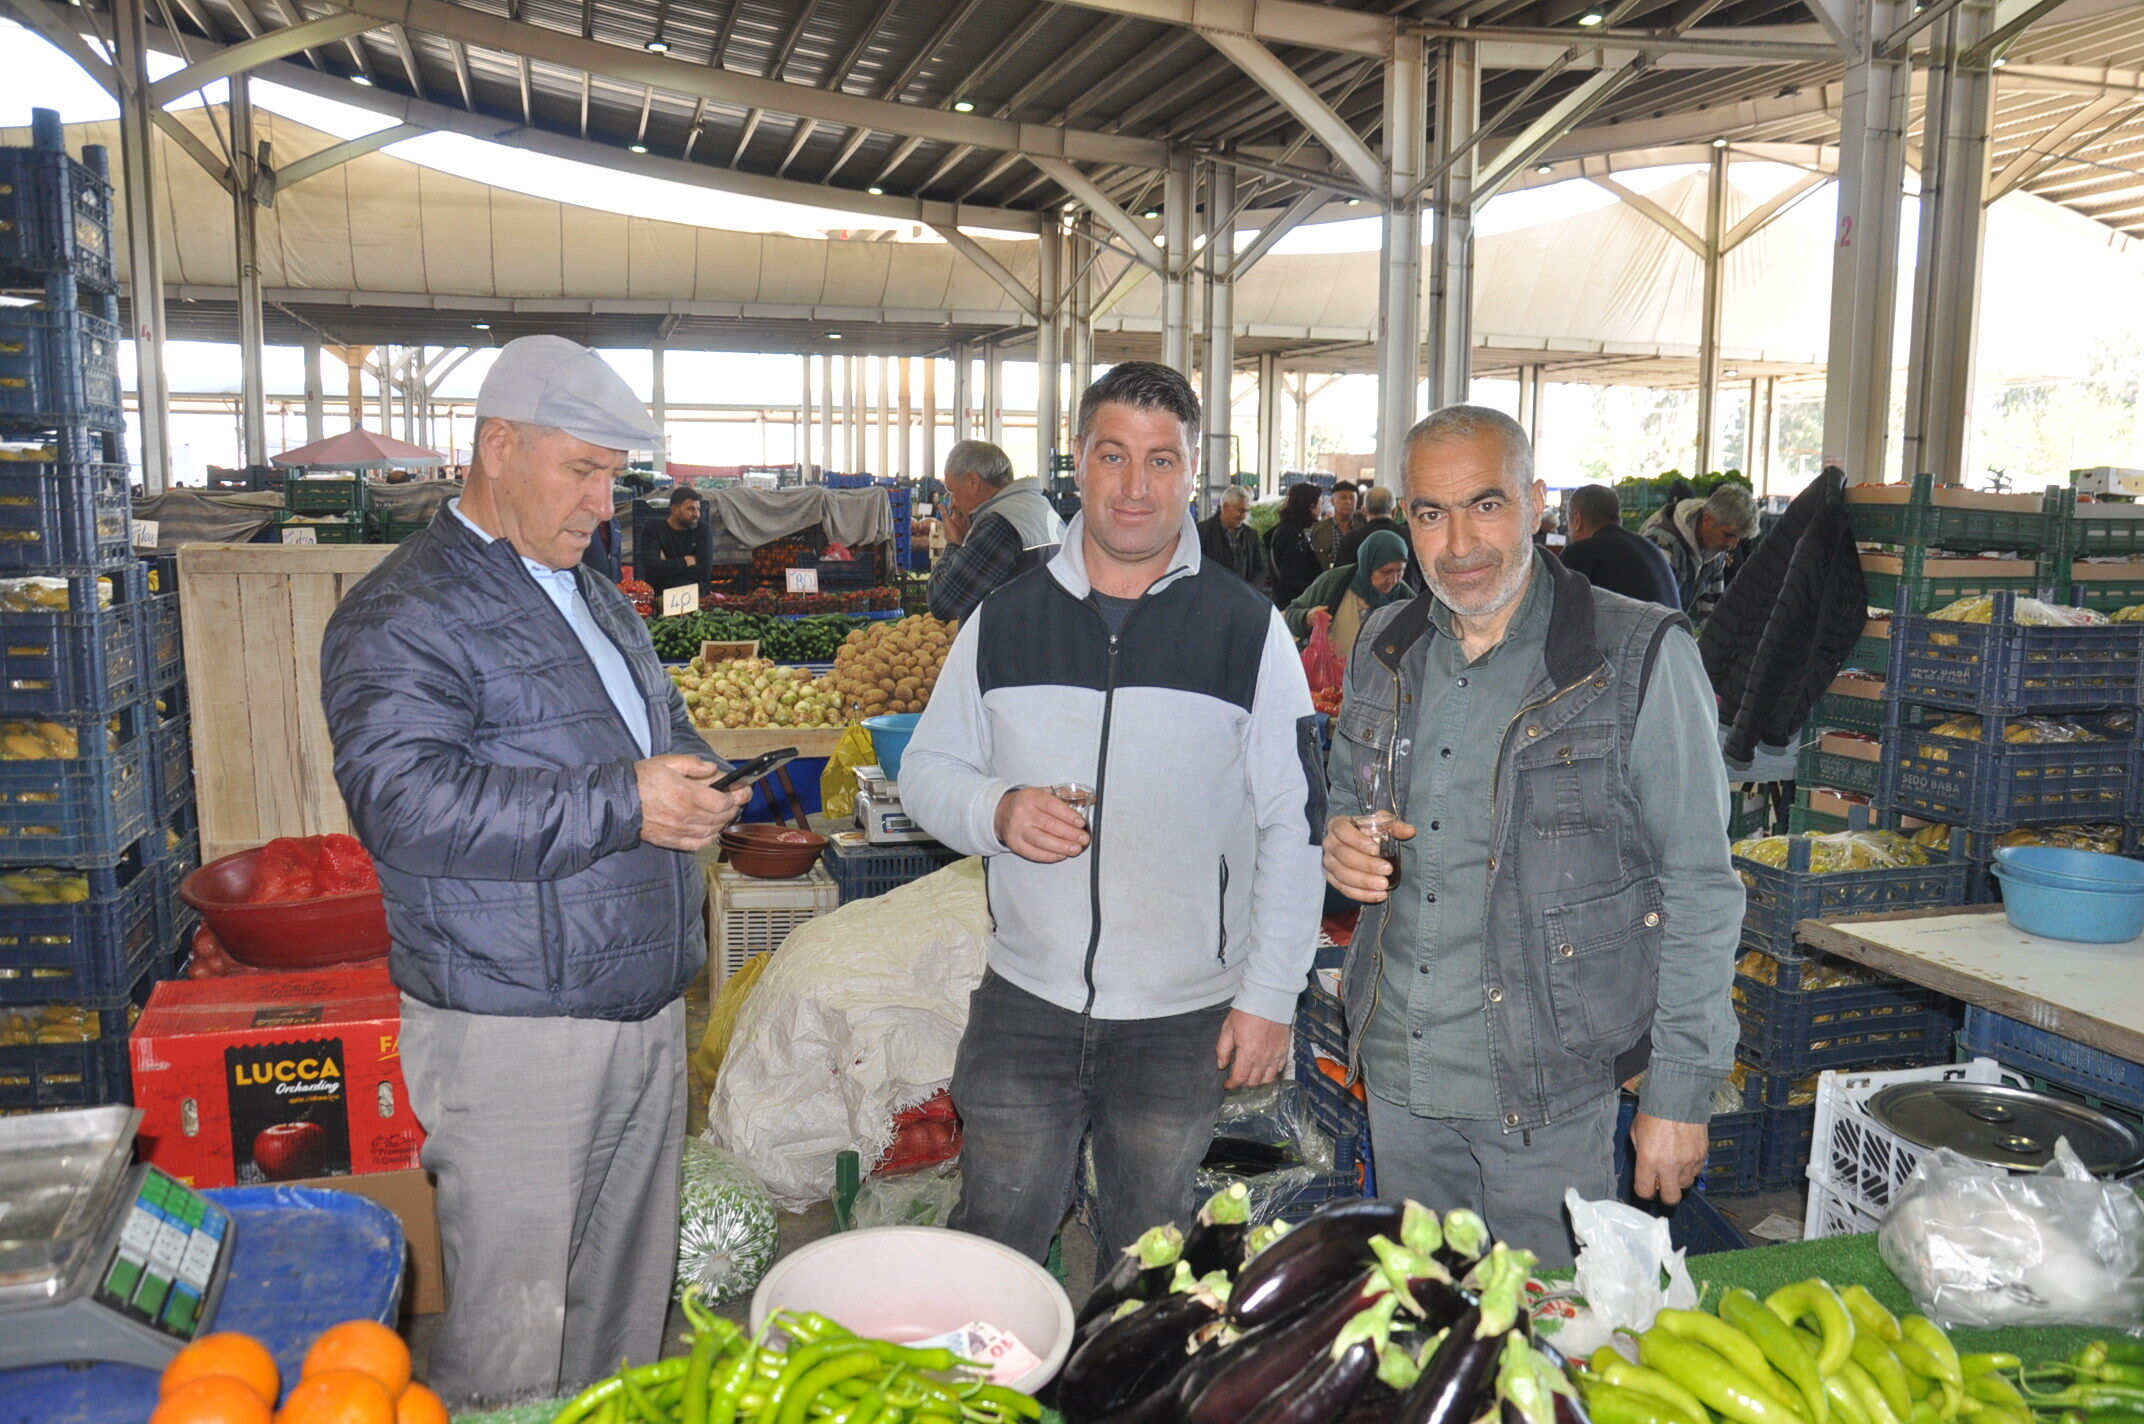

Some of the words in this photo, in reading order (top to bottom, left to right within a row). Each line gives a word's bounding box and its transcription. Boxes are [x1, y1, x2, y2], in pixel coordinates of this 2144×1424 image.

[1840, 214, 1852, 248] 2
[795, 572, 813, 590] 80
[670, 591, 692, 608] 40
[1901, 773, 1928, 787] SEDO
[1930, 779, 1960, 793] BABA
[235, 1057, 340, 1087] LUCCA
[275, 1079, 340, 1095] Orcharding
